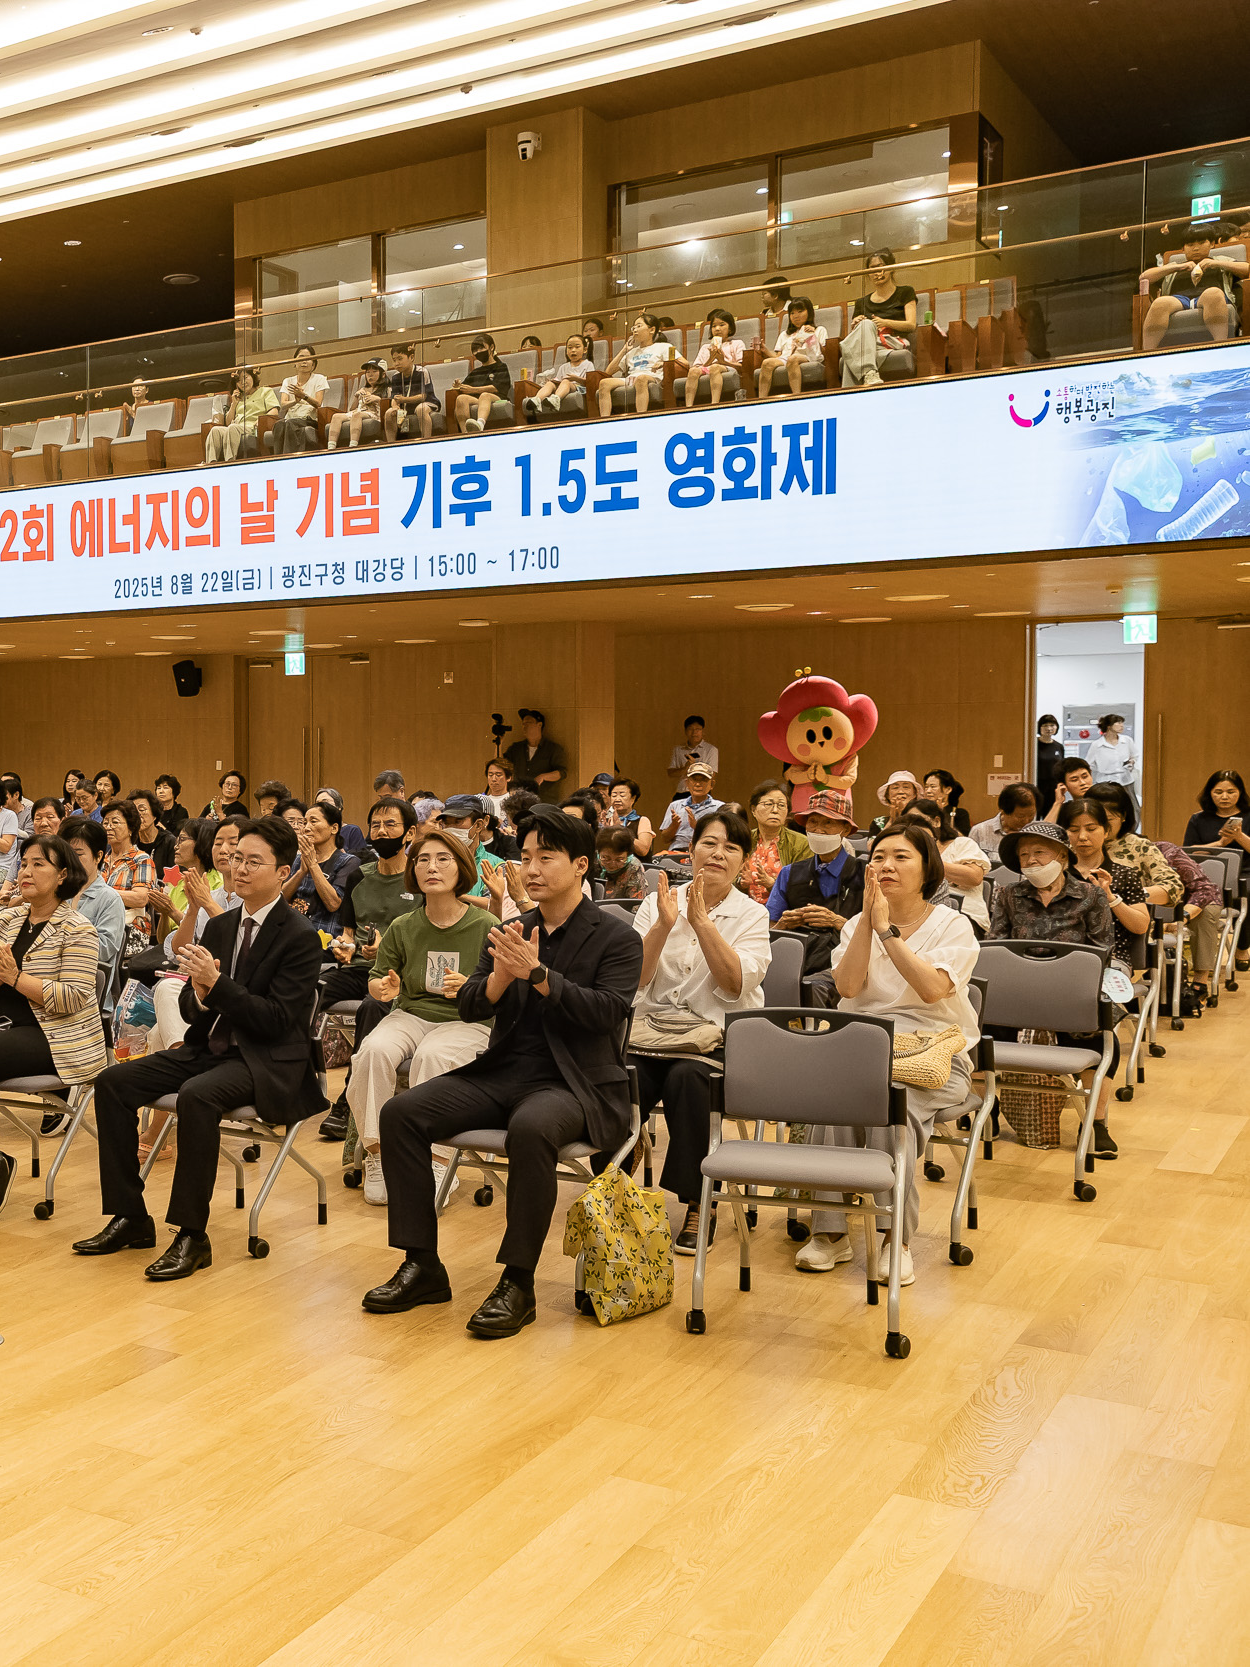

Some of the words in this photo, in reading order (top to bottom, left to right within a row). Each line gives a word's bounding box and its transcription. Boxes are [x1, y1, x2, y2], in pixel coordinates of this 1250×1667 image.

[1056, 397, 1115, 424] 행복광진
[70, 485, 220, 557] 에너지의
[240, 479, 278, 545] 날
[296, 468, 379, 537] 기념
[401, 455, 491, 529] 기후
[515, 441, 639, 516] 1.5도
[664, 417, 837, 508] 영화제
[115, 576, 162, 598] 2025년
[171, 573, 192, 595] 8월
[202, 569, 261, 592] 22일(금)
[282, 562, 344, 588] 광진구청
[356, 557, 404, 583] 대강당
[429, 552, 476, 577] 15:00
[509, 546, 559, 571] 17:00
